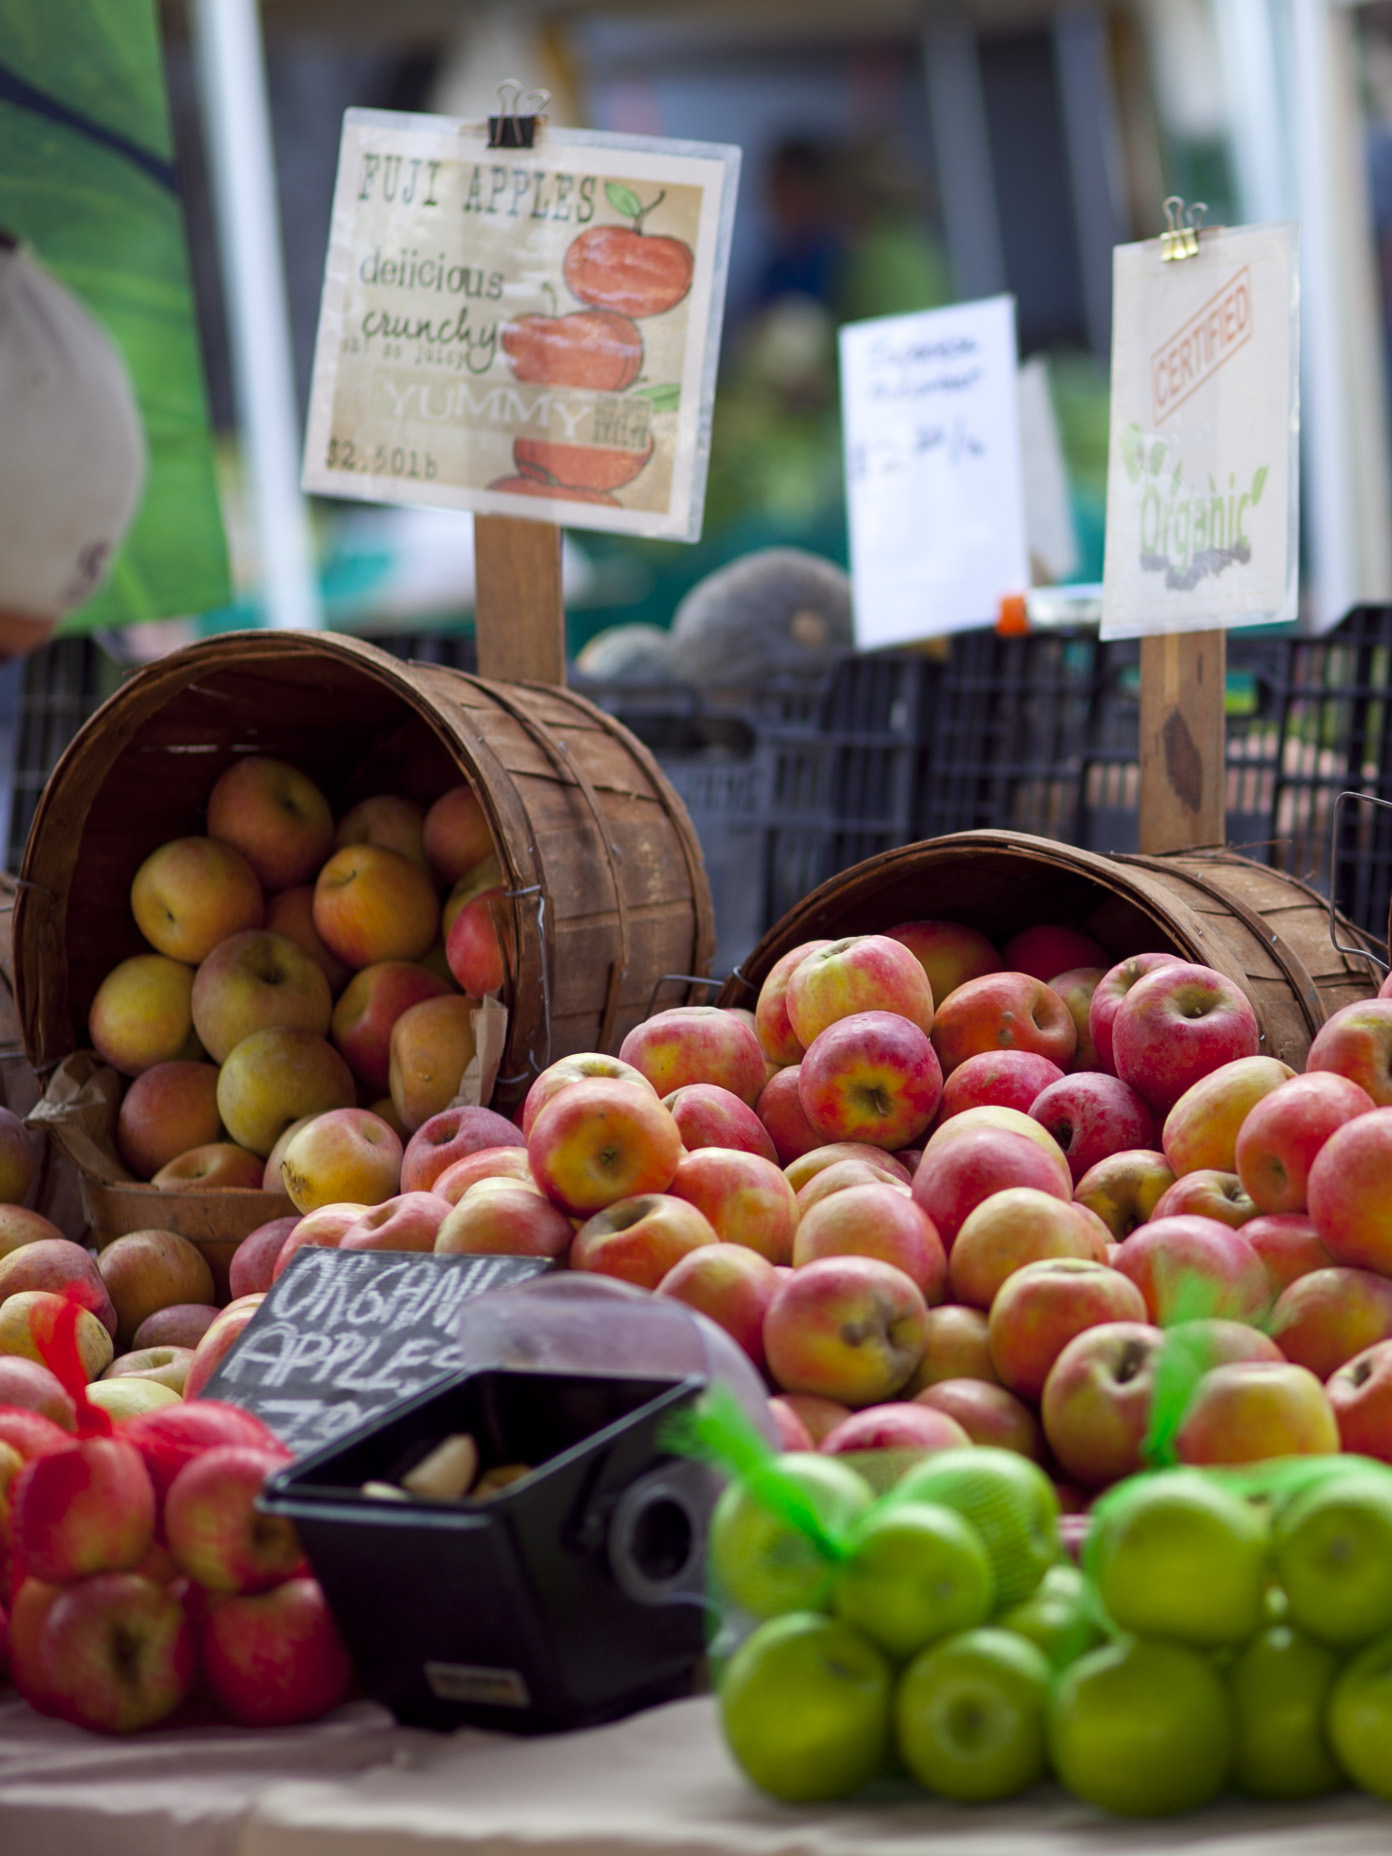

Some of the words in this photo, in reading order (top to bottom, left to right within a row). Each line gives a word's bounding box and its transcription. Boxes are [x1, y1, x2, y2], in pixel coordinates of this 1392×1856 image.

[358, 153, 441, 206] FUJI
[463, 164, 597, 224] APPLES
[362, 305, 498, 375] crunchy
[1154, 282, 1249, 407] CERTIFIED
[383, 381, 594, 438] YUMMY
